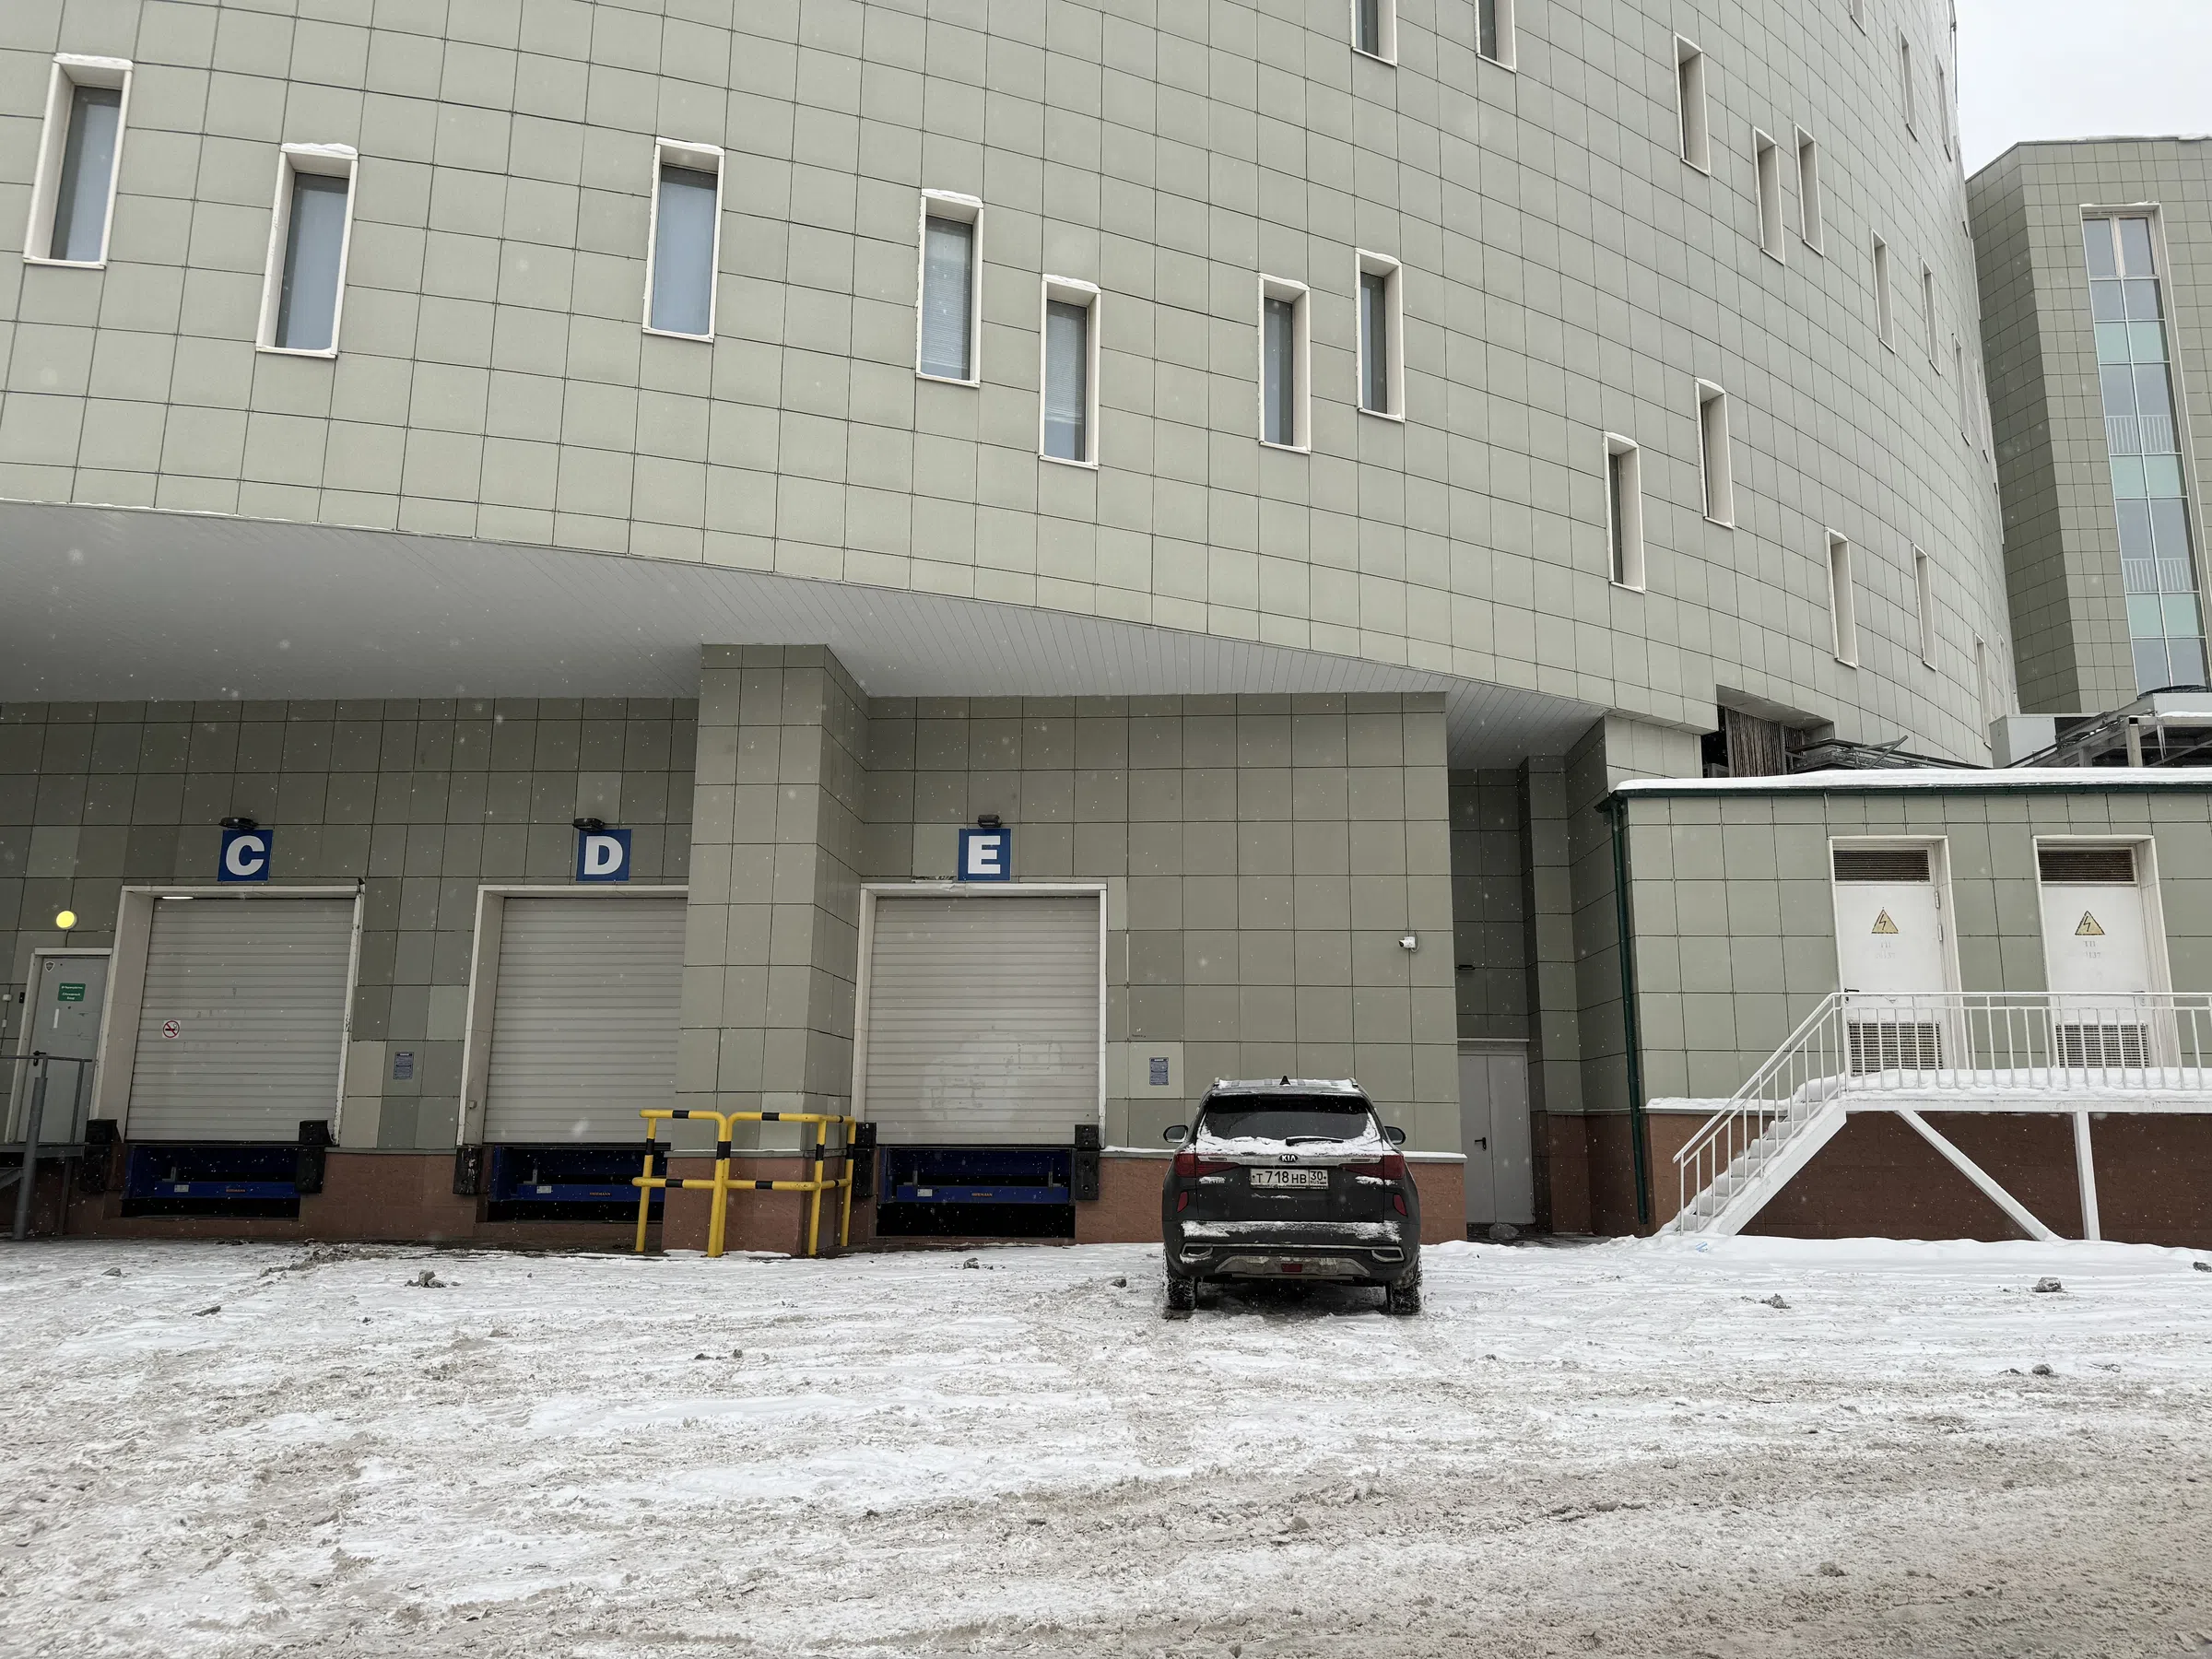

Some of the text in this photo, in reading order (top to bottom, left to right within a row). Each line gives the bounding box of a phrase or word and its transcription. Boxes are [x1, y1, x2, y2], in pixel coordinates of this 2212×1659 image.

[226, 835, 265, 876] C
[584, 836, 623, 875] D
[968, 835, 1001, 874] E
[1281, 1154, 1297, 1162] KIA
[1310, 1171, 1324, 1181] 30
